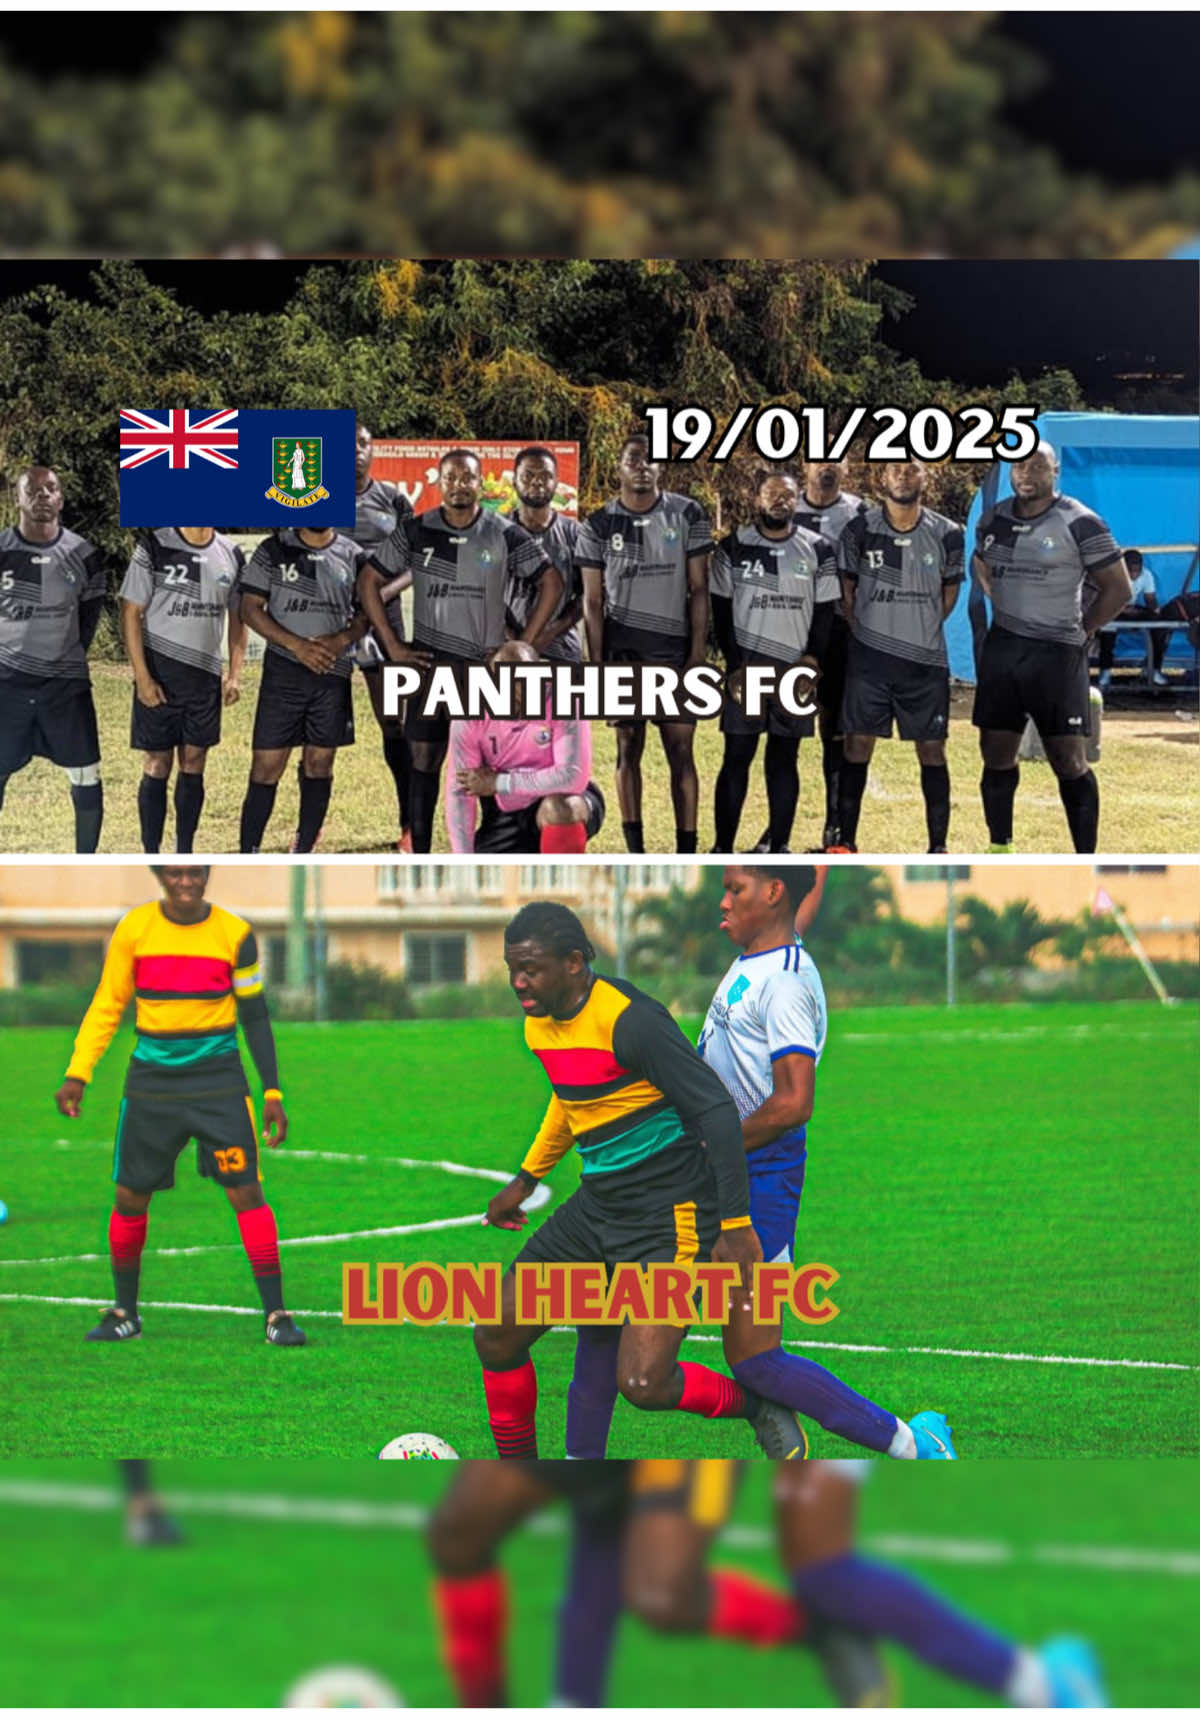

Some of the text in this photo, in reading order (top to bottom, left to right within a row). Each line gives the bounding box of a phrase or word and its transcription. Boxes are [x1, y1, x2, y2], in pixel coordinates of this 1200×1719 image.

[611, 533, 625, 552] 8
[422, 547, 435, 568] 7
[865, 549, 885, 570] 13
[163, 563, 189, 585] 22
[278, 562, 299, 582] 16
[740, 559, 765, 579] 24
[1, 569, 15, 591] 5
[213, 1146, 248, 1174] 13
